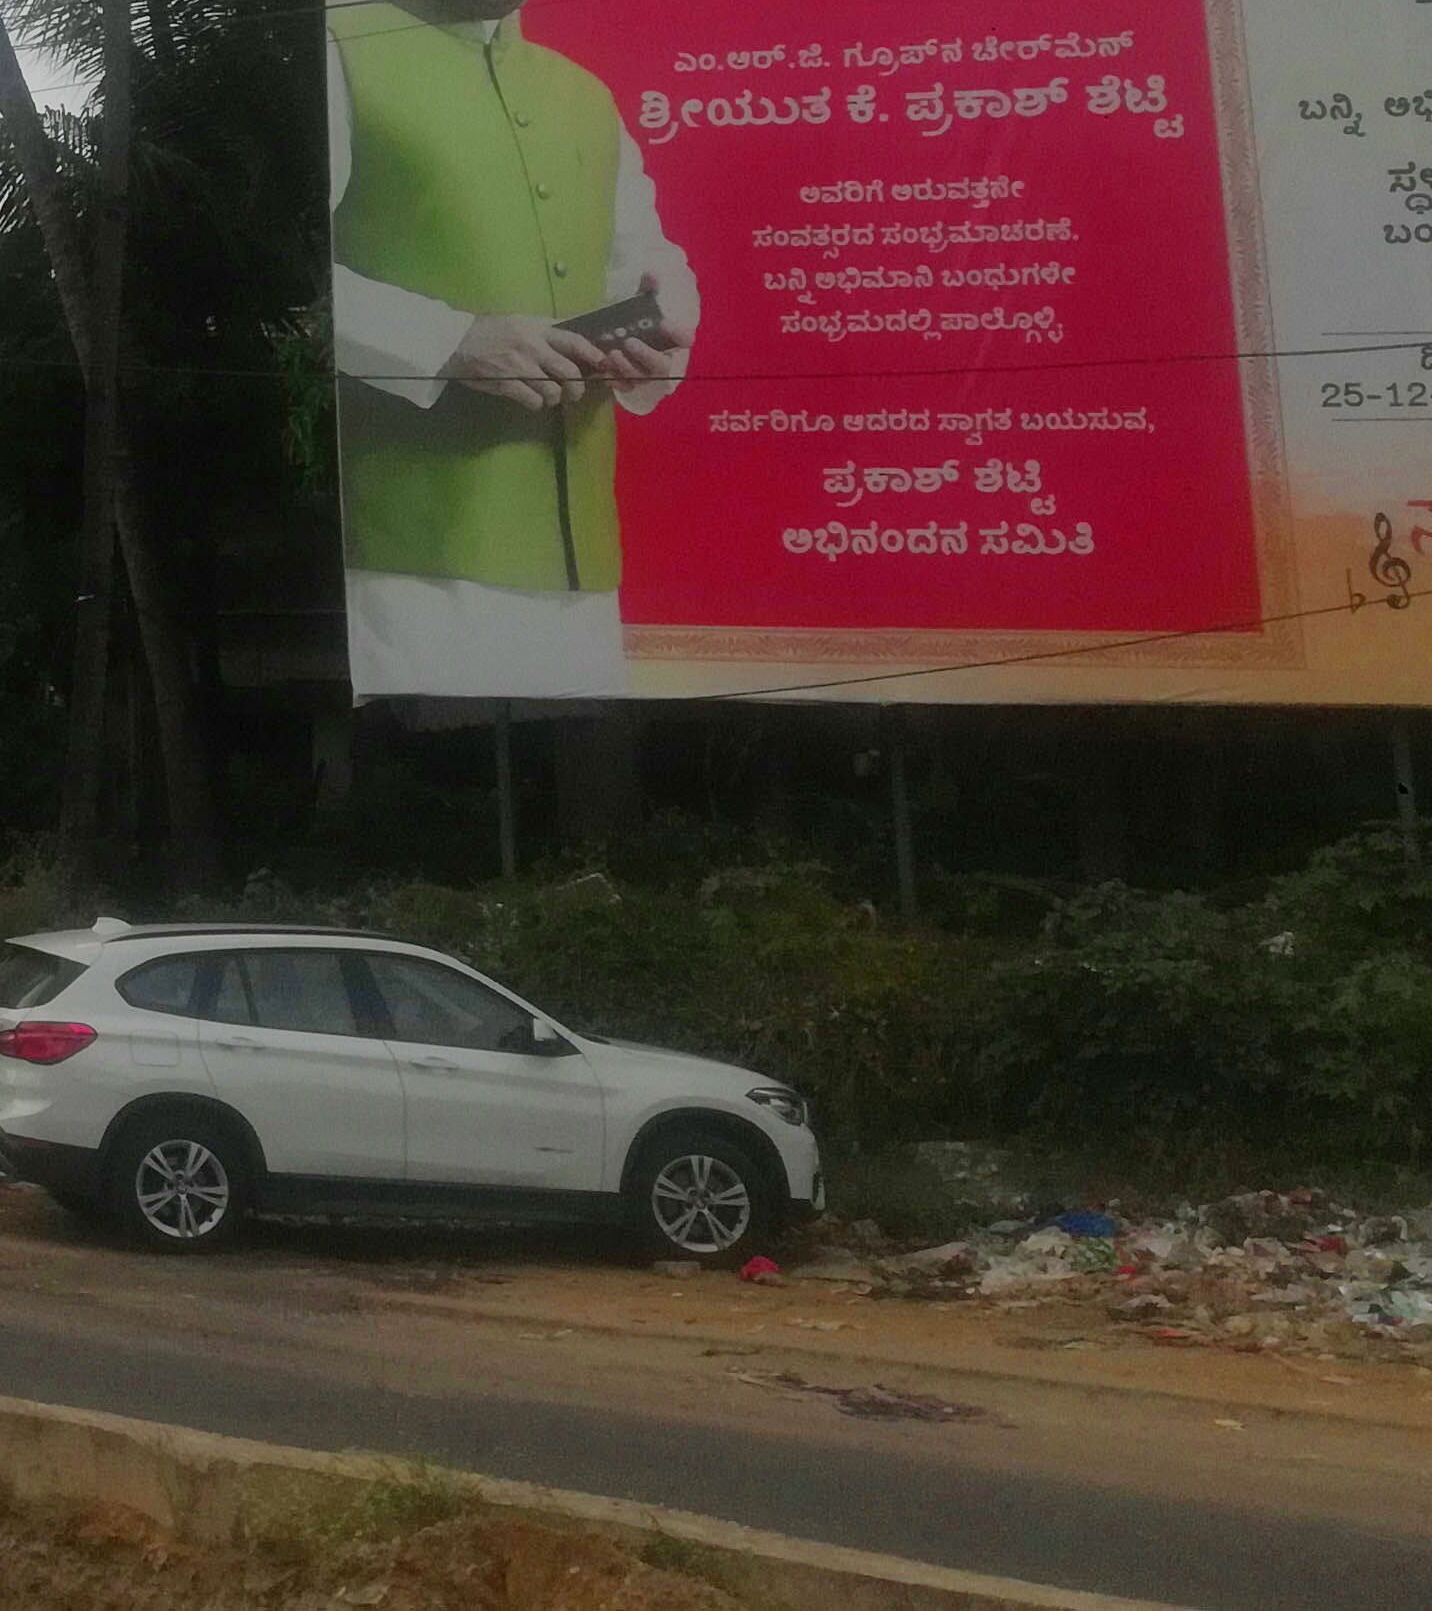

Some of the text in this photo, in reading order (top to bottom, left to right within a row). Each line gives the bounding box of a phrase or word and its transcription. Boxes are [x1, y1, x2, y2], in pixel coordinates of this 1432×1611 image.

[638, 72, 1185, 145] ಶ್ರೀಯುತ ಕೆ. ಪ್ರಕಾಶ್ ಶೆಟ್ಟಿ
[1298, 92, 1365, 137] ಬನ್ನಿ
[799, 179, 884, 204] ಅವರಿಗೆ
[751, 222, 874, 259] ಸಂವತ್ಸರದ
[764, 261, 1077, 305] ಬನ್ನಿ ಅಭಿಮಾನಿ ಬಂಧುಗಳೇ
[779, 307, 942, 342] ಸಂಭ್ರಮದಲ್ಲಿ
[709, 409, 836, 433] ಸರ್ವರಿಗೂ
[842, 409, 930, 431] ಆದರದ
[936, 408, 1012, 445] ಸ್ವಾಗತ
[821, 458, 1057, 515] ಪ್ರಕಾಶ್ ಶೆಟ್ಟಿ
[781, 520, 1095, 562] ಅಭಿನಂದನ ಸಮಿತಿ
